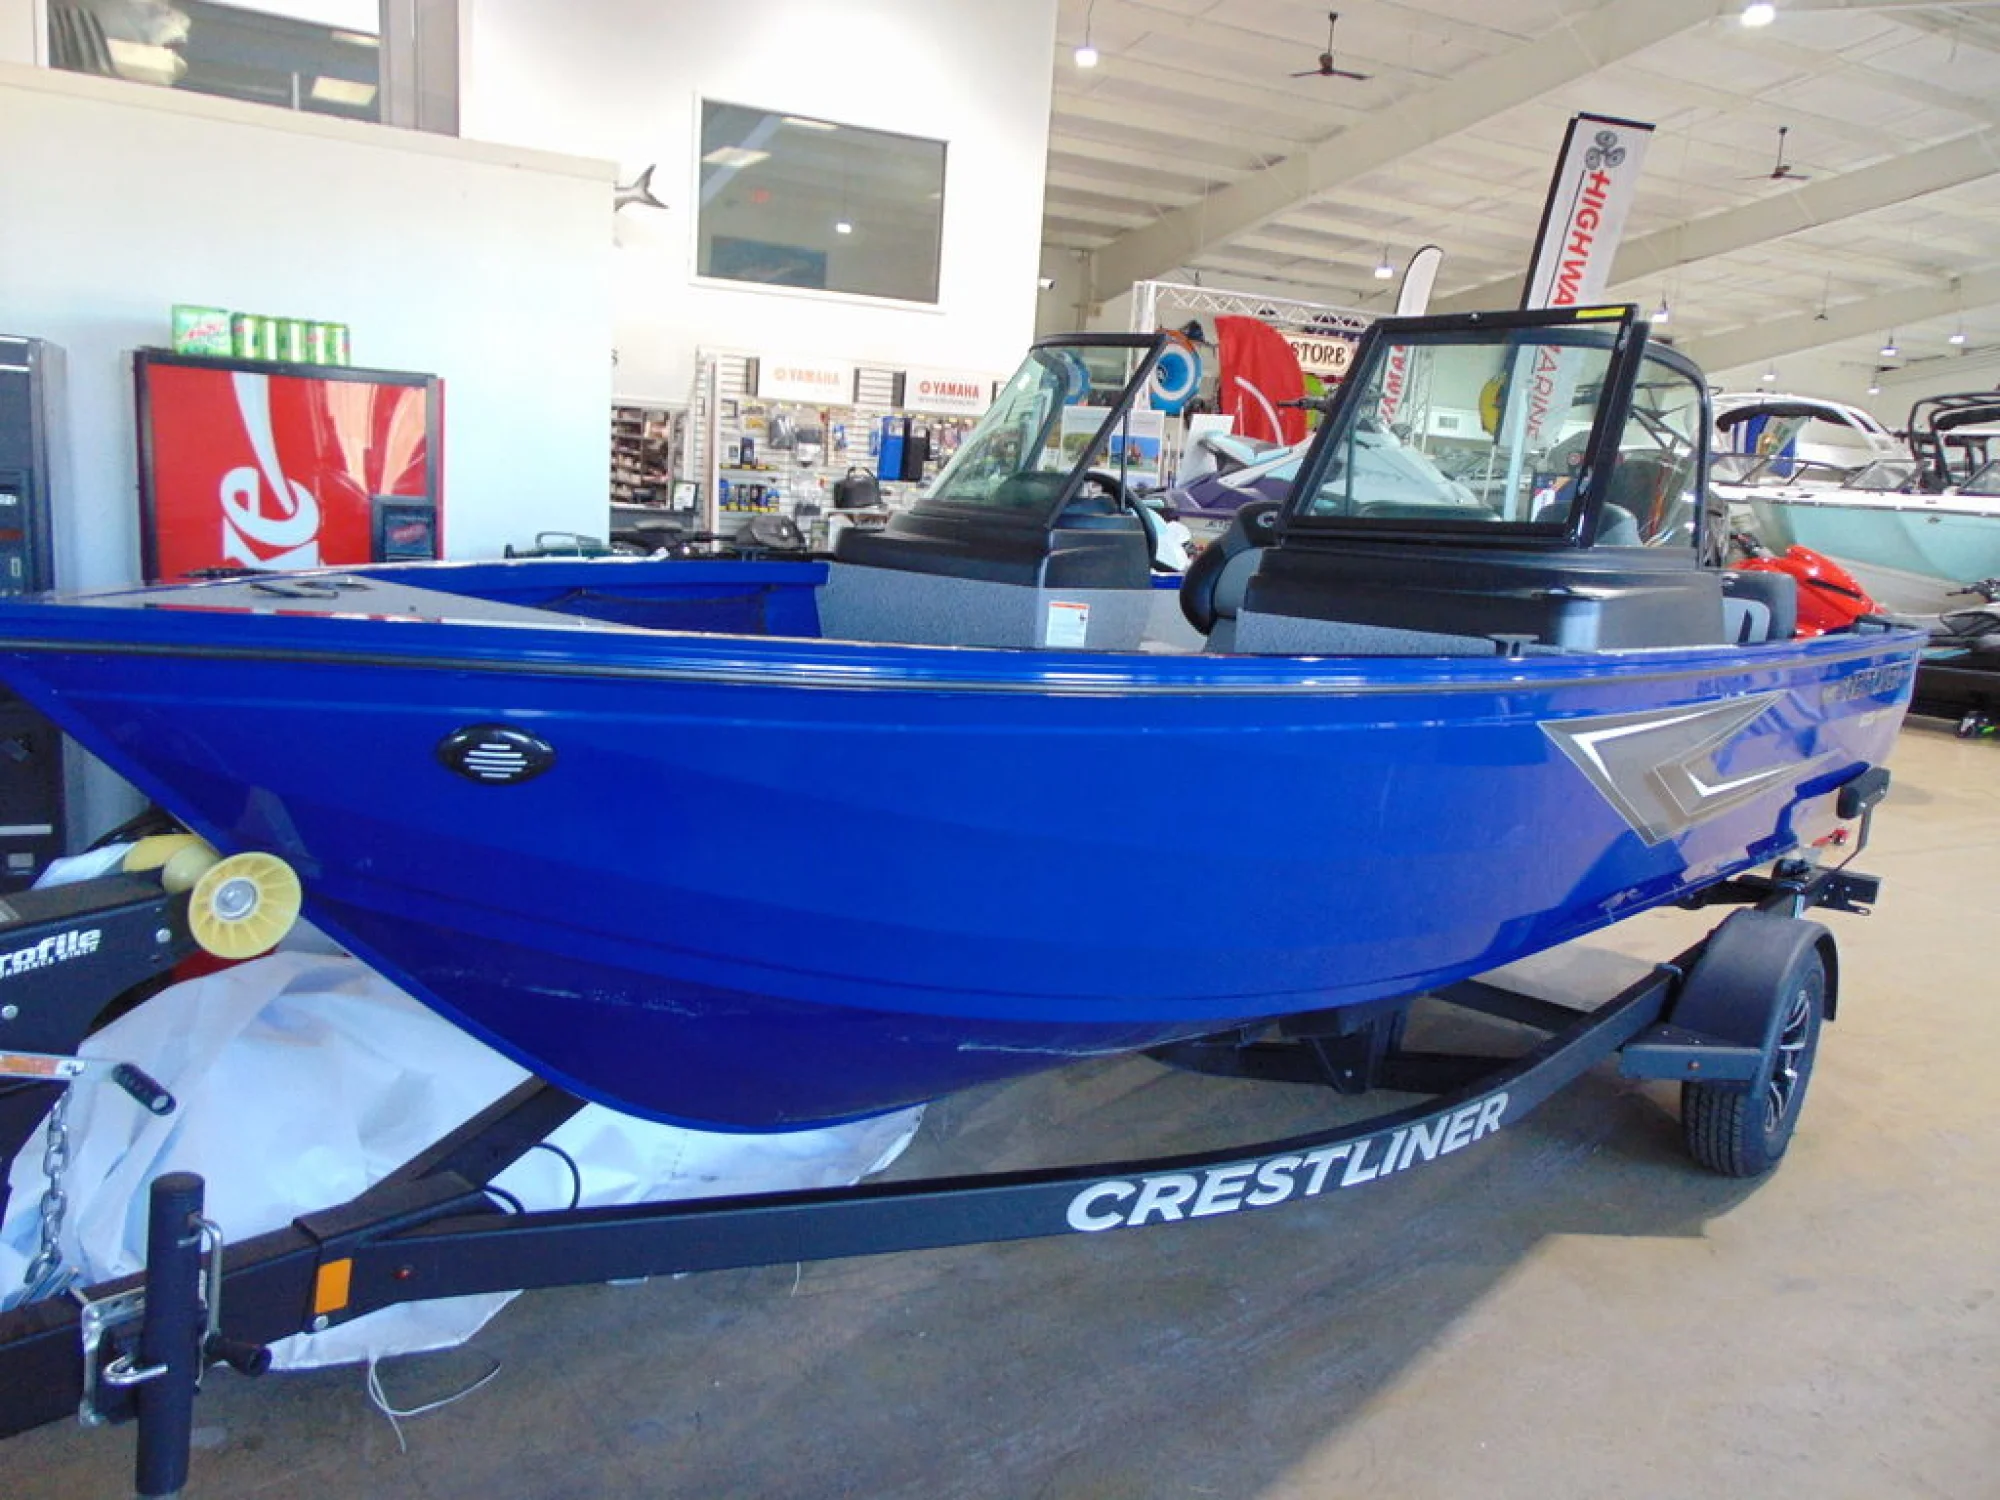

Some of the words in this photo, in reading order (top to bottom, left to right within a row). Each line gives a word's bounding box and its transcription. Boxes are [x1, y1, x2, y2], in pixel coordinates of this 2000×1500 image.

[1553, 170, 1611, 305] HIGHWA
[788, 368, 840, 386] YAMAHA
[933, 381, 979, 399] YAMAHA
[0, 929, 102, 976] rofile
[1066, 1092, 1509, 1231] CRESTLINER
